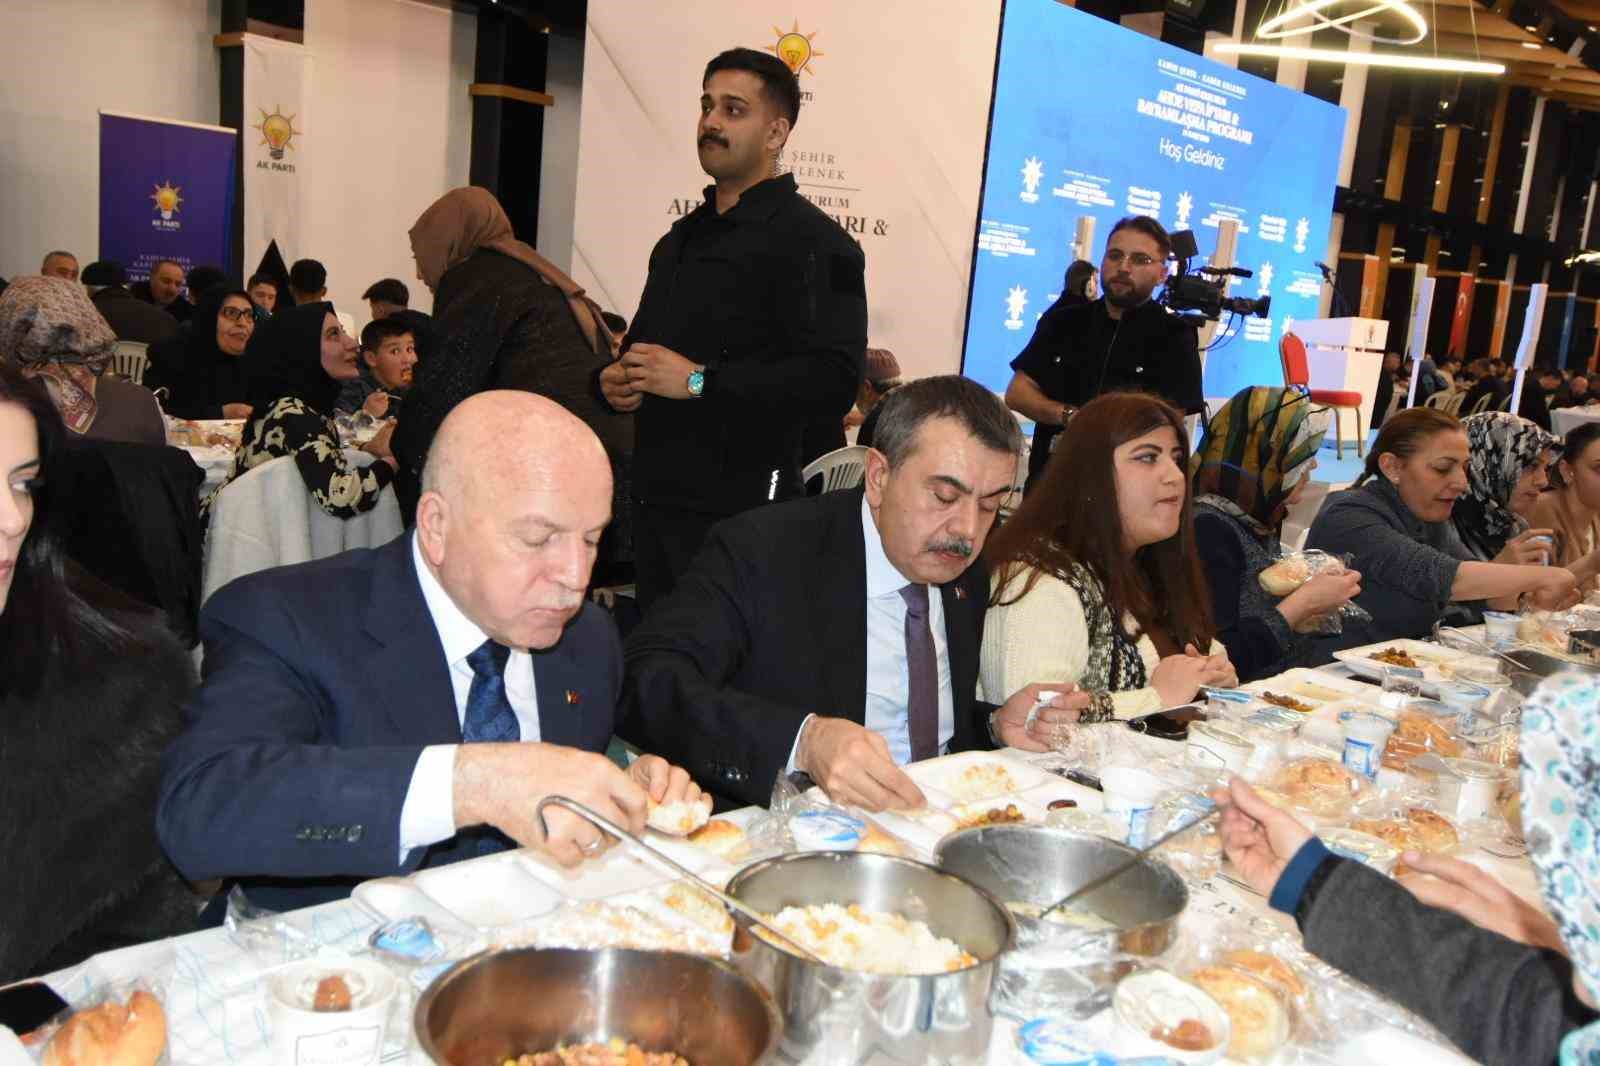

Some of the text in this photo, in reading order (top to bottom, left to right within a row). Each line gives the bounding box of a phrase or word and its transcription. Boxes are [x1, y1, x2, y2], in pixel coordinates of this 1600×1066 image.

[1160, 137, 1225, 170] Hoş Geldiniz
[256, 160, 269, 169] AK
[873, 219, 888, 236] &
